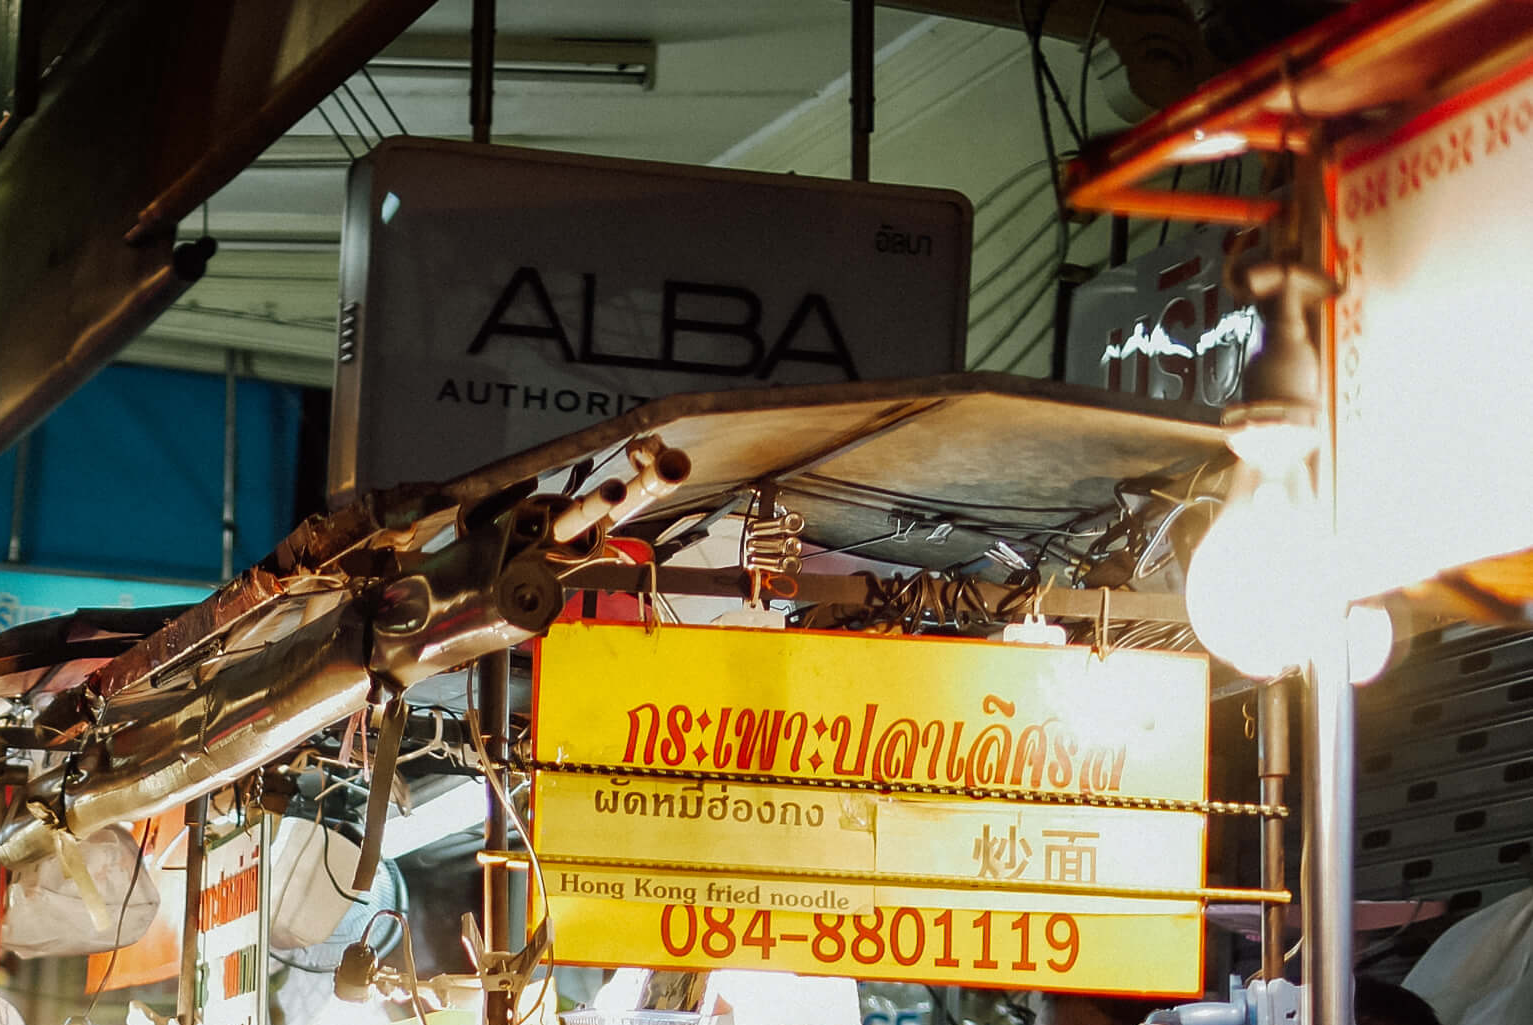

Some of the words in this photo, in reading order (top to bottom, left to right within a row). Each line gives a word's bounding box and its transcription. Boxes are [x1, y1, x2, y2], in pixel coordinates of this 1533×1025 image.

[468, 266, 860, 380] ALBA
[559, 872, 625, 900] Hong
[633, 877, 697, 904] Kong
[705, 882, 761, 905] fried
[770, 887, 850, 911] noodle
[660, 903, 1081, 974] 084-8801119
